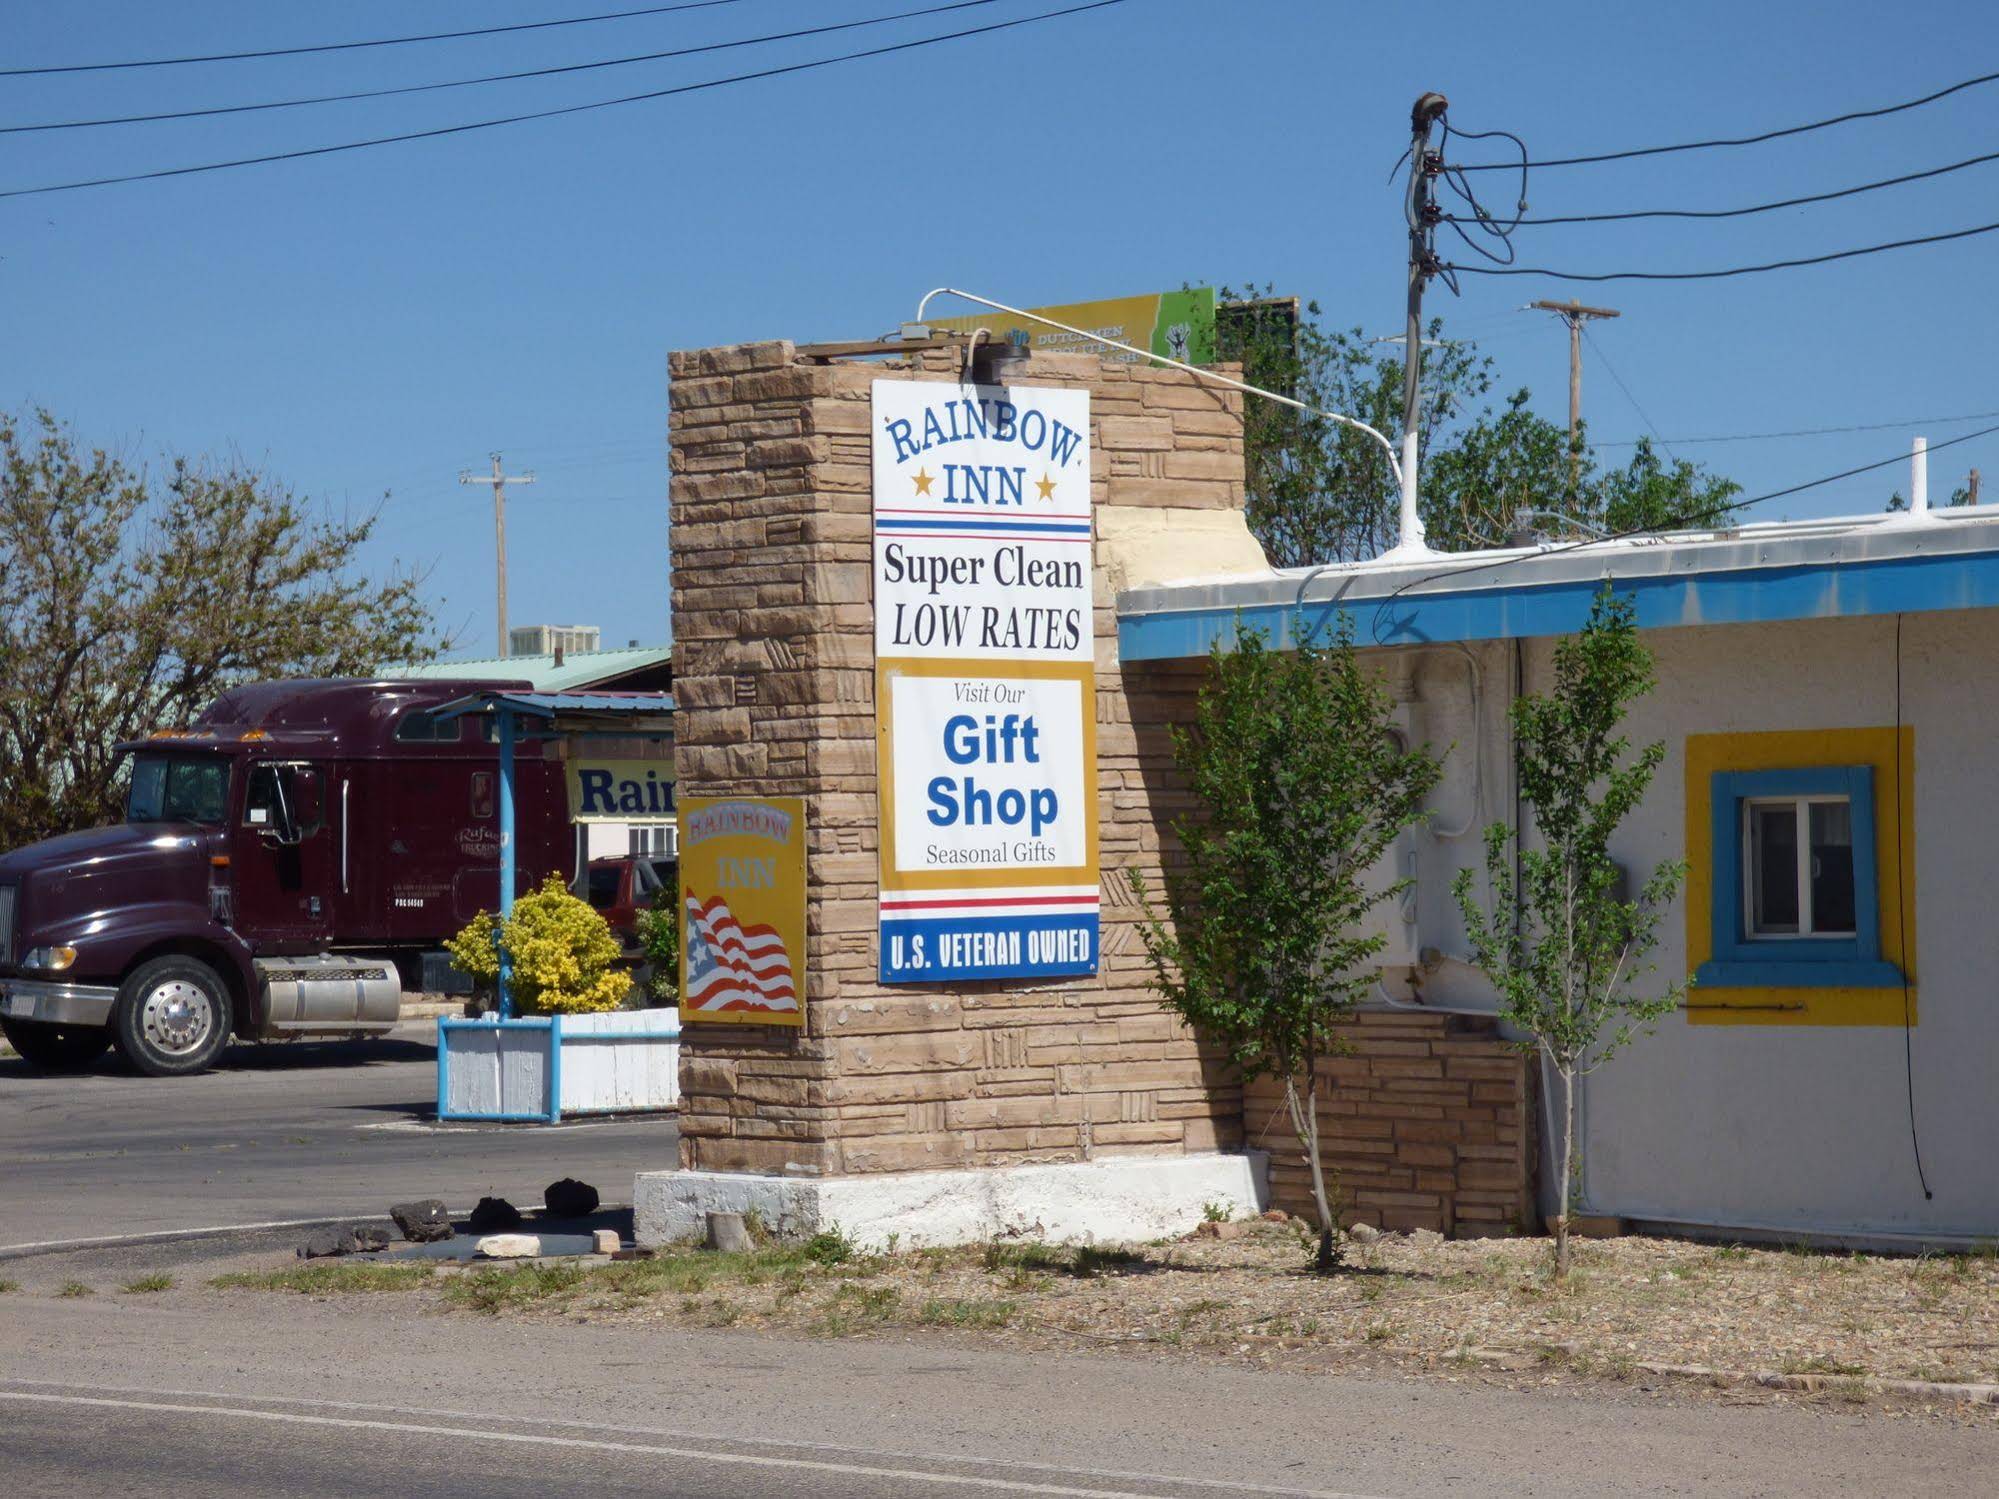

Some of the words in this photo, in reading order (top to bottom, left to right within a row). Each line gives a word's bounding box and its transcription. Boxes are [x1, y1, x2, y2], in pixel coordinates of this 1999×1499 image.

[885, 399, 1082, 468] RAINBOW
[943, 464, 1026, 505] INN
[884, 543, 985, 595] Super
[994, 546, 1084, 589] Clean
[892, 603, 971, 648] LOW
[979, 606, 1081, 651] RATES
[954, 682, 991, 703] Visit
[994, 683, 1026, 704] Our
[943, 714, 1040, 765] Gift
[687, 802, 792, 846] RAINBOW
[927, 776, 1058, 837] Shop
[717, 857, 777, 889] INN
[926, 842, 1008, 865] Seasonal
[1013, 841, 1056, 863] Gifts
[891, 933, 931, 970] U.S.
[939, 931, 1020, 968] VETERAN
[1028, 928, 1090, 964] OWNED
